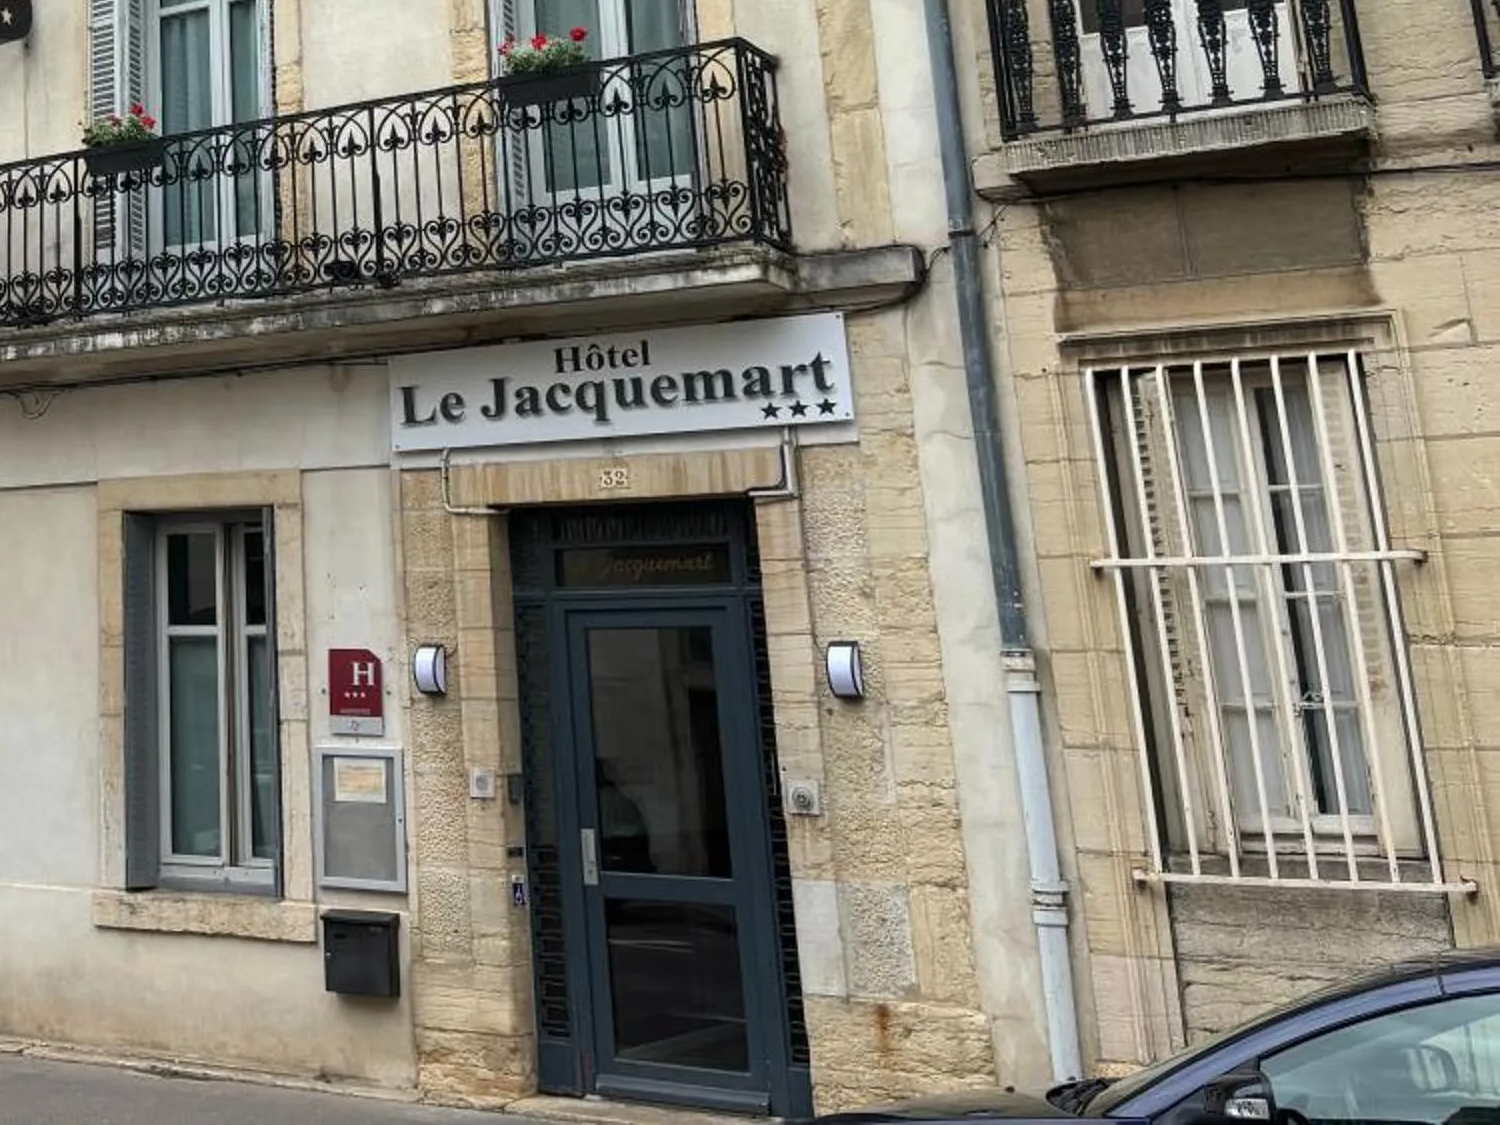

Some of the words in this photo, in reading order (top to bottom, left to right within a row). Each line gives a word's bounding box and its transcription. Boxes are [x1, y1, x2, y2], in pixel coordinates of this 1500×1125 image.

[554, 339, 651, 373] Hôtel
[402, 385, 466, 425] Le
[481, 352, 835, 425] Jacquemart
[603, 470, 625, 486] 32
[352, 661, 375, 686] H
